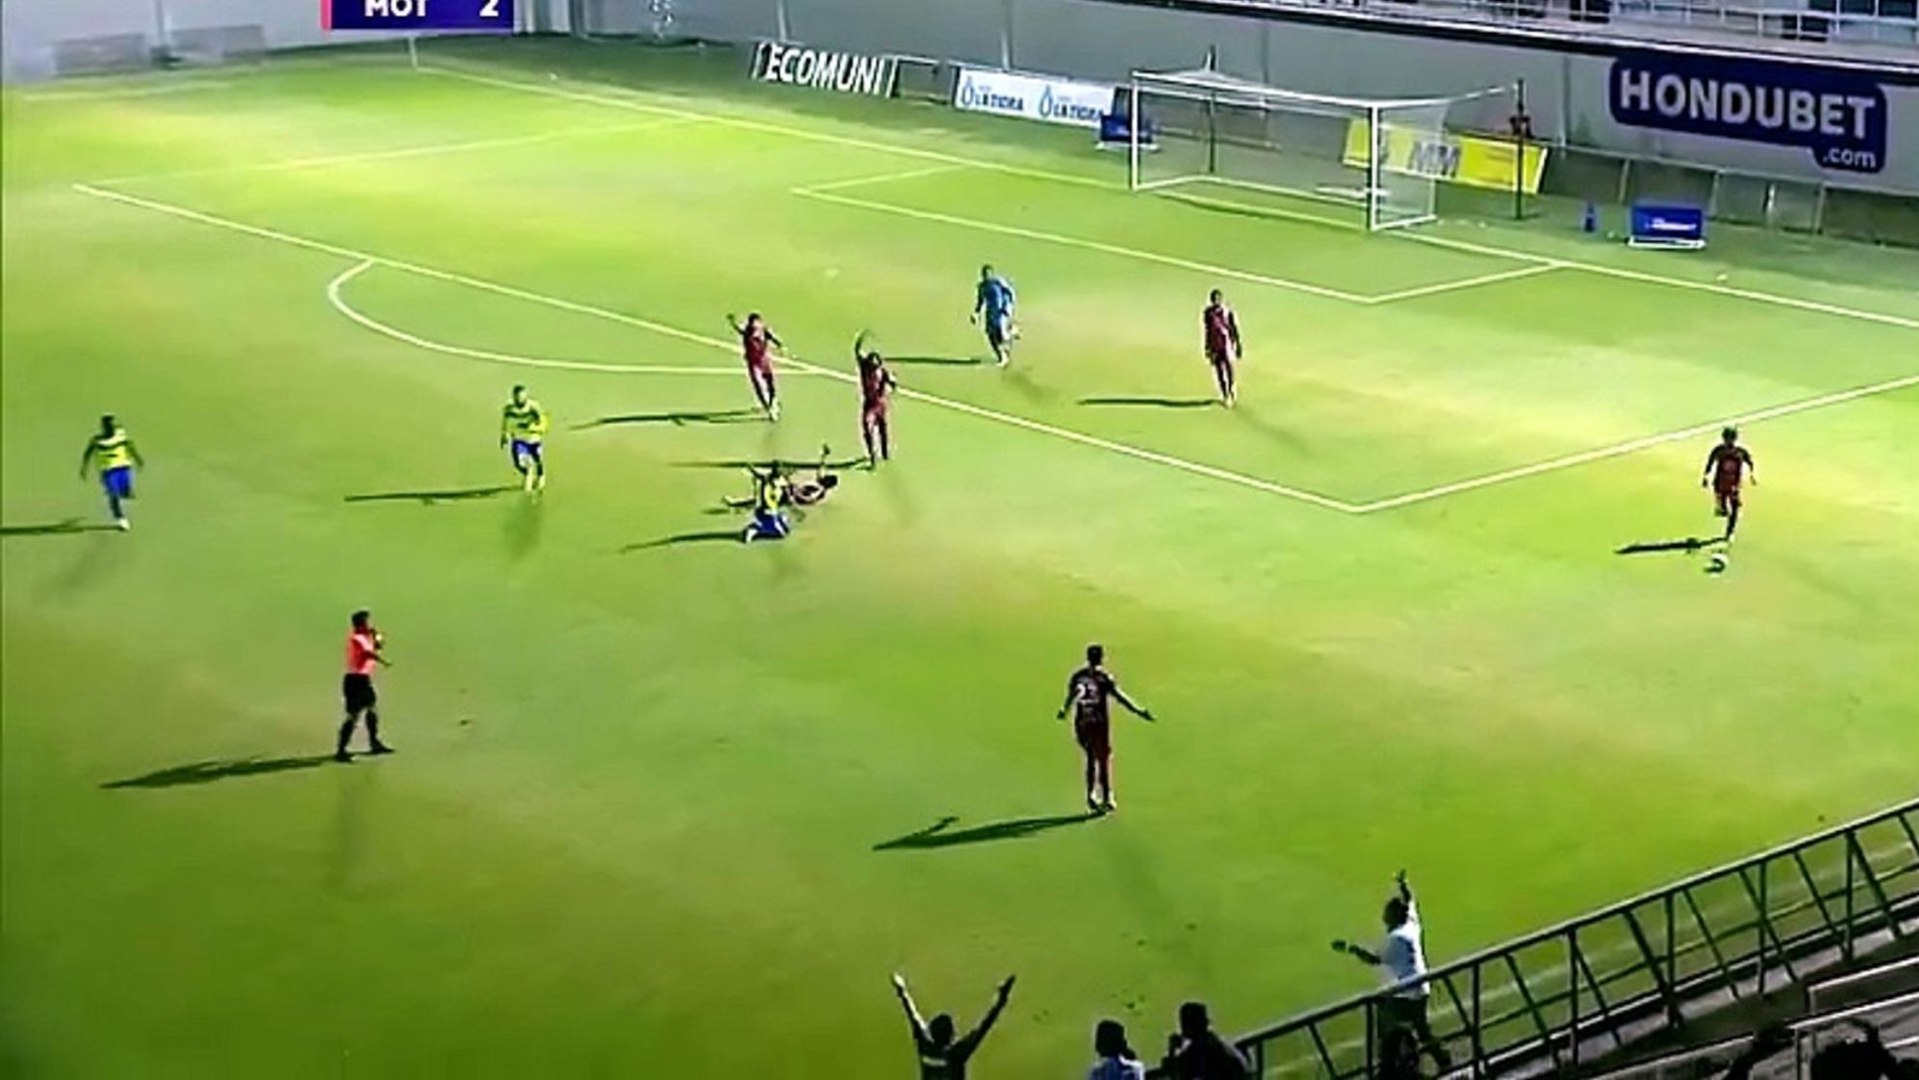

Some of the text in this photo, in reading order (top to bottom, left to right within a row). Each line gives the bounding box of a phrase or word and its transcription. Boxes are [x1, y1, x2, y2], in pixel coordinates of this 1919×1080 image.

[765, 44, 886, 96] ECOMUNI
[1620, 69, 1876, 139] HONDUBET
[1822, 148, 1877, 168] .com
